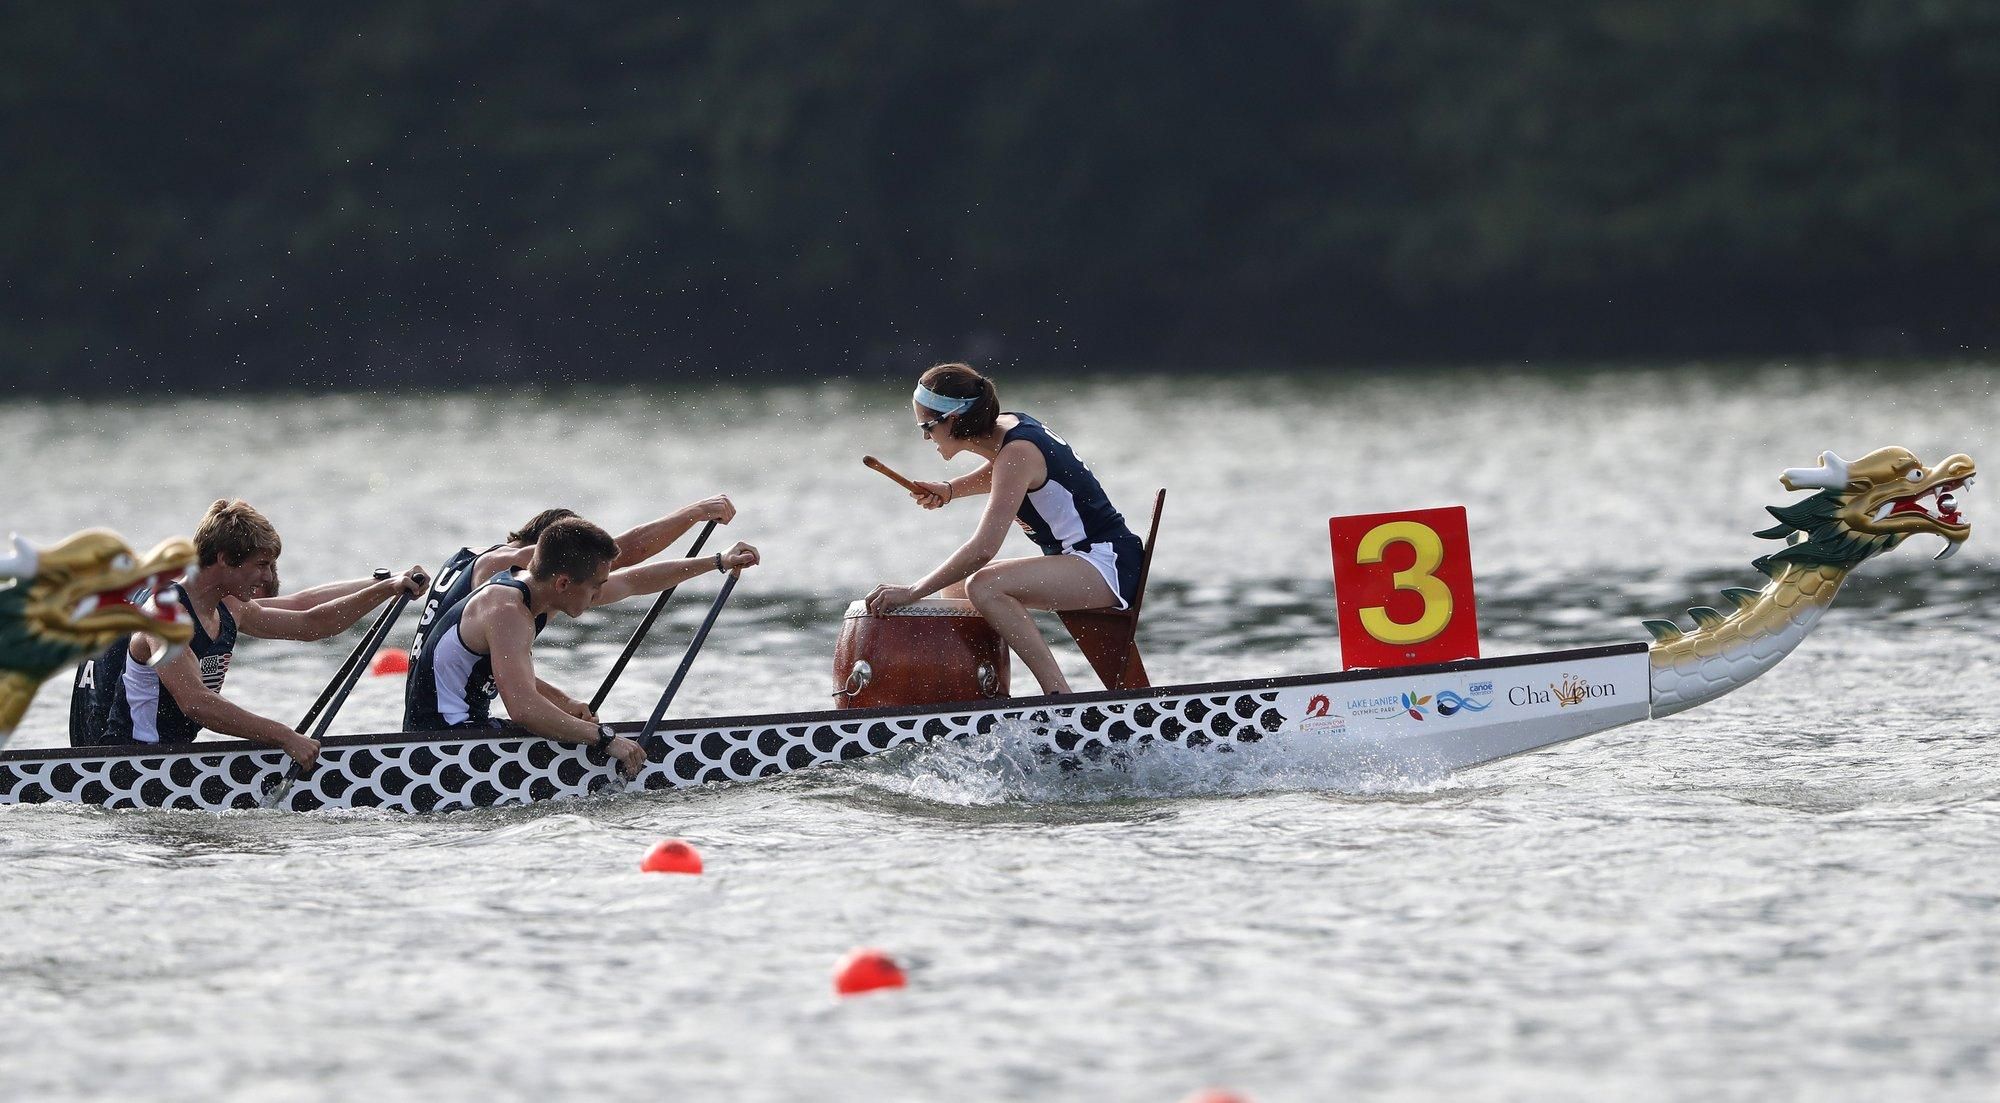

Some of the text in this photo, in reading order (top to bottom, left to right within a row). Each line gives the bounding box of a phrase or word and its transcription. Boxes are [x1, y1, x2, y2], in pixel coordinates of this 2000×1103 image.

[1357, 521, 1453, 645] 3
[410, 566, 462, 661] USA
[1347, 696, 1398, 710] LAKE LANIER
[1352, 708, 1379, 716] OLYMPIC
